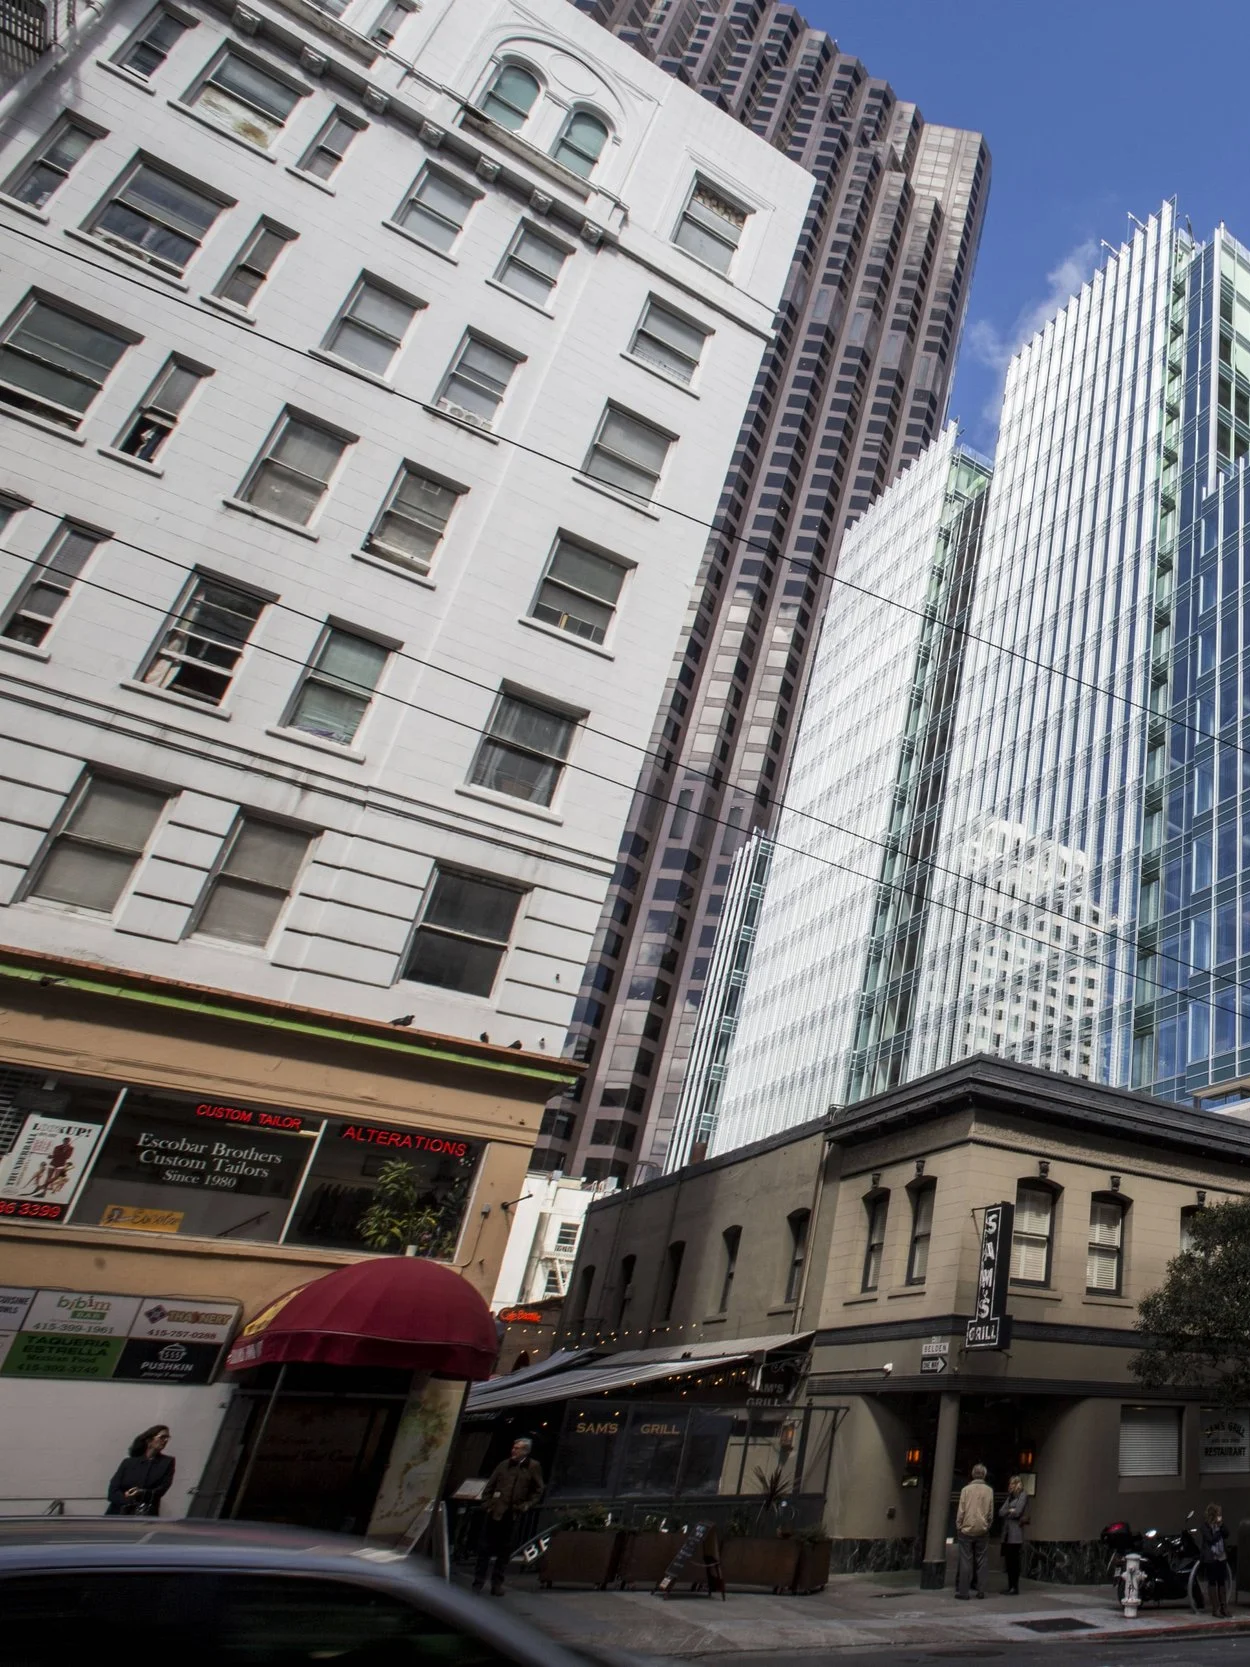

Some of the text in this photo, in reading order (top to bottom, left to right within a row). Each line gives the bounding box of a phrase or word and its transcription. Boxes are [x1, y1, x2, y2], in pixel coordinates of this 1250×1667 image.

[196, 1104, 302, 1129] CUSTOM TAILOR
[136, 1132, 283, 1164] Escobar Brothers
[341, 1125, 468, 1157] ALTERATIONS
[139, 1149, 270, 1178] Custom Tailors
[162, 1169, 237, 1189] Since 1980
[27, 1335, 111, 1348] TAQUERIA
[968, 1324, 997, 1341] GRILL
[22, 1345, 108, 1356] ESTRELLA
[140, 1361, 195, 1372] PUSHKIN
[640, 1423, 680, 1435] GRILL
